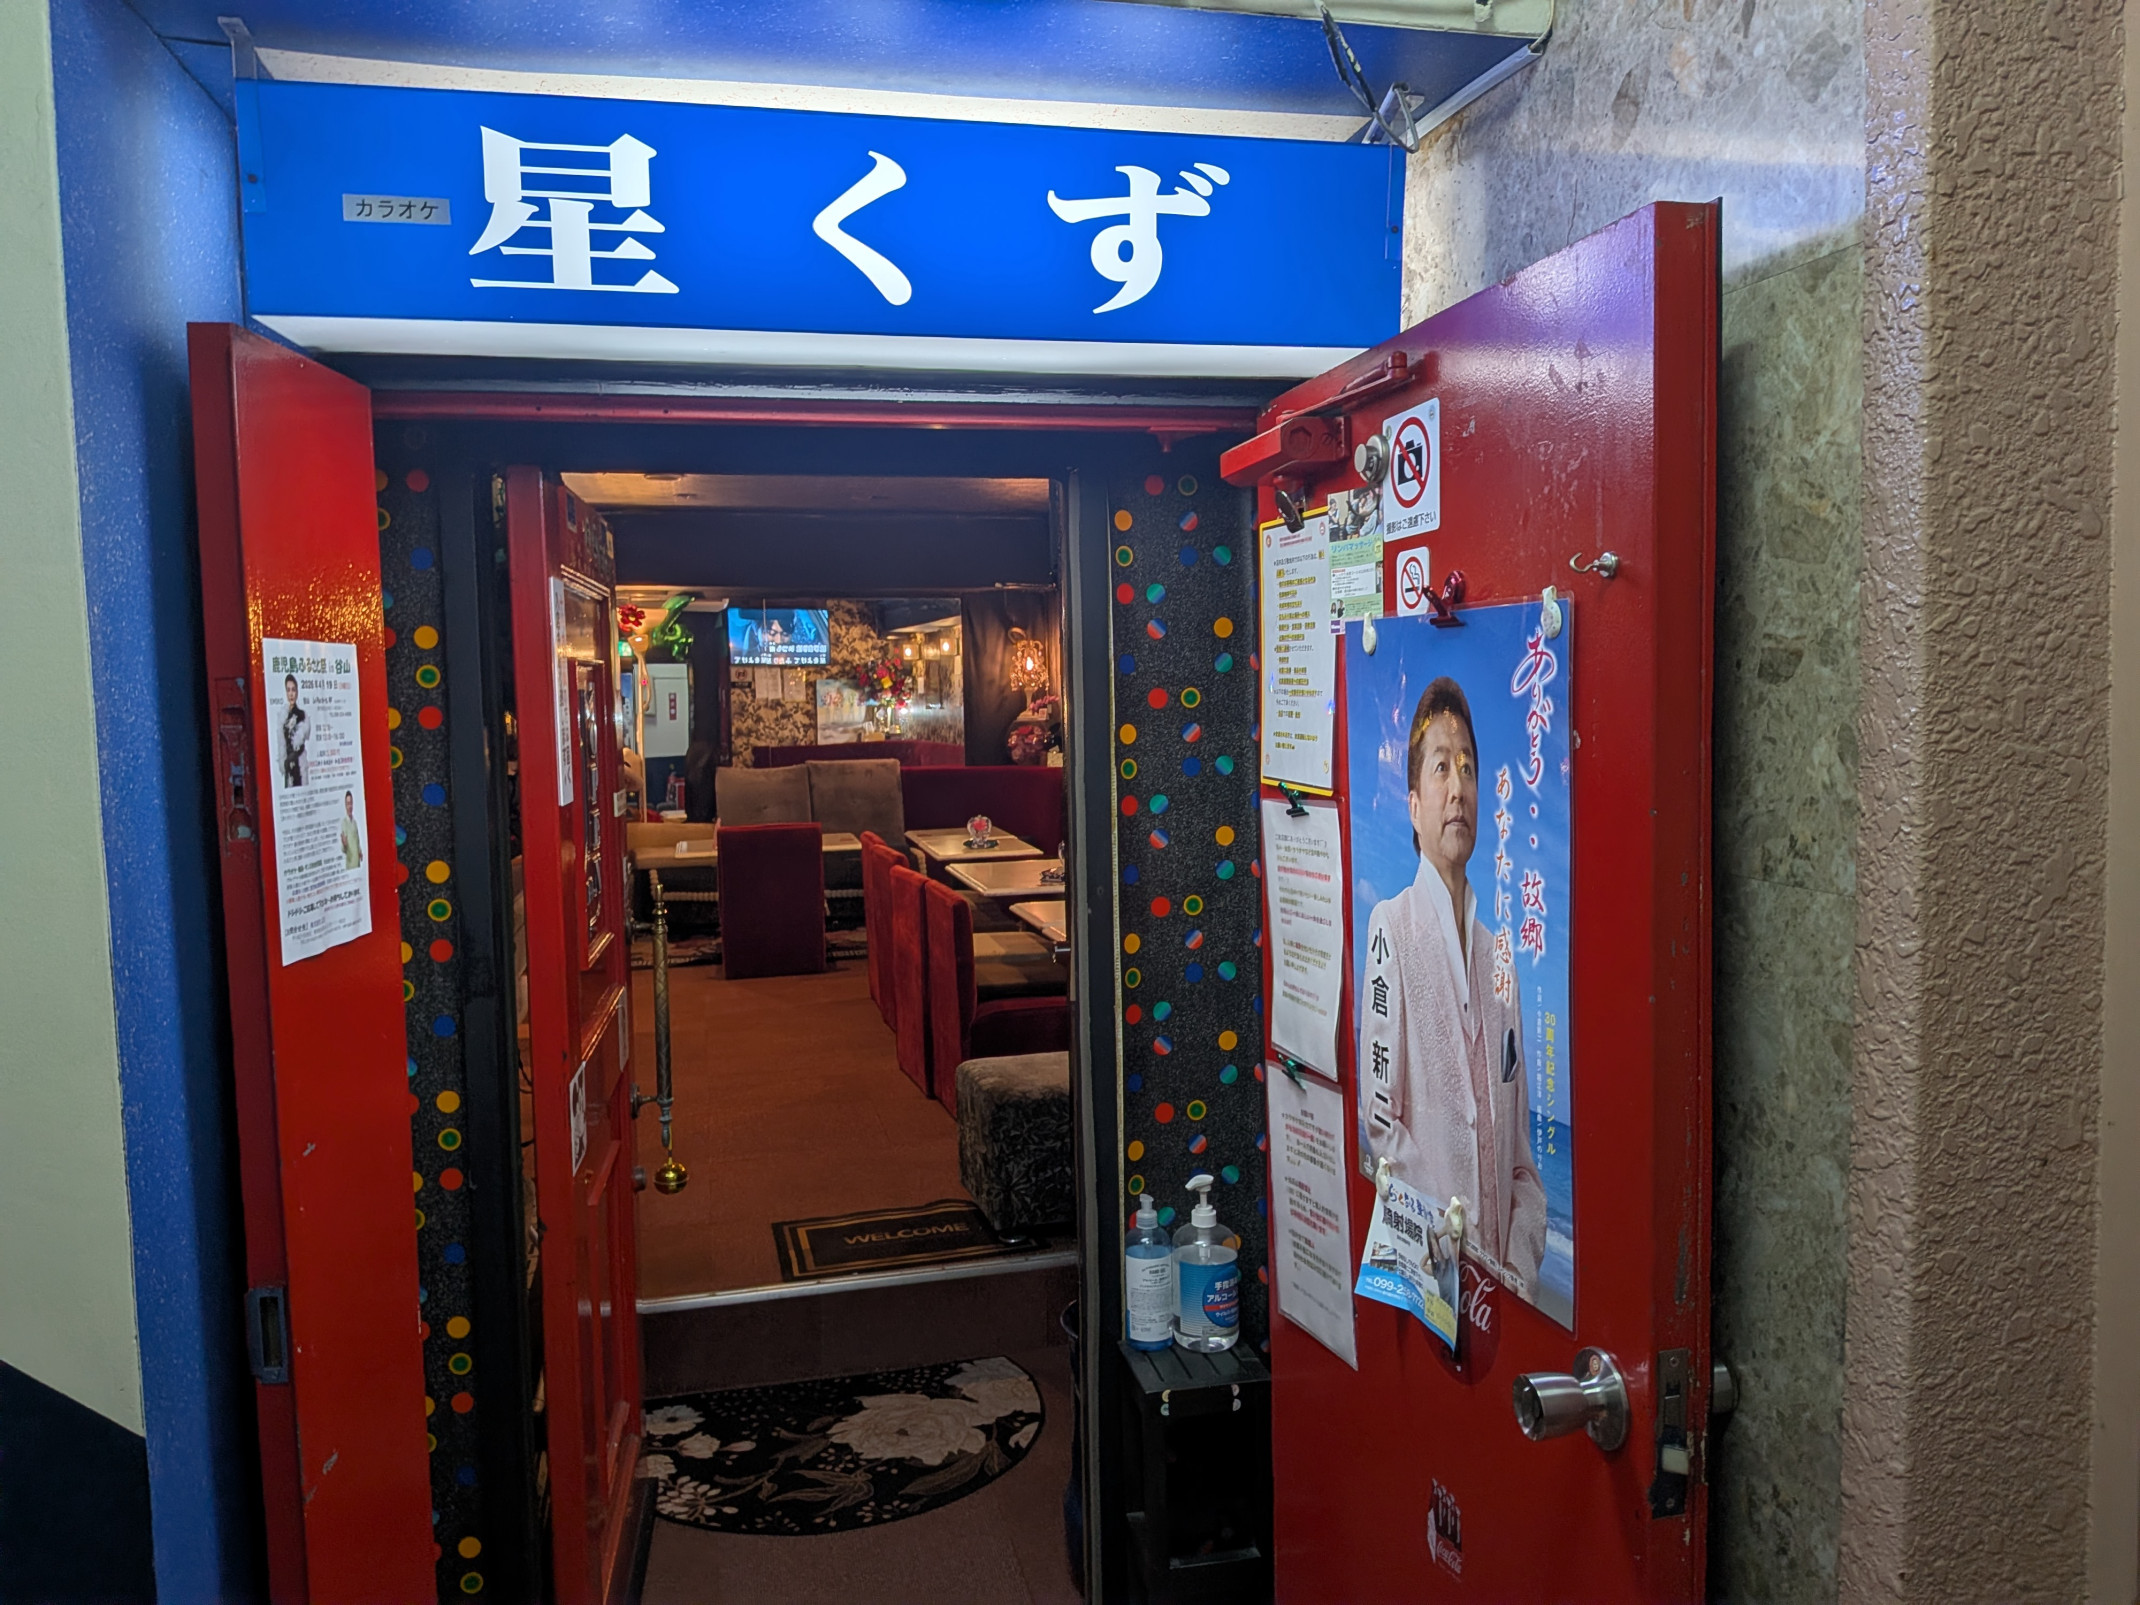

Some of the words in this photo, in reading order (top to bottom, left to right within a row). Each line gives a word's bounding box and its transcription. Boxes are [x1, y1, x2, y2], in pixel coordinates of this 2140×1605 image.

[355, 198, 440, 221] カラオケ
[468, 125, 1231, 314] 星くず
[1386, 511, 1437, 535] 撮影はご遠慮下さい
[1331, 540, 1373, 553] リンパマッサージ
[334, 659, 351, 675] 谷山
[1493, 766, 1512, 1003] あなたに感謝
[843, 1222, 970, 1245] WELCOME
